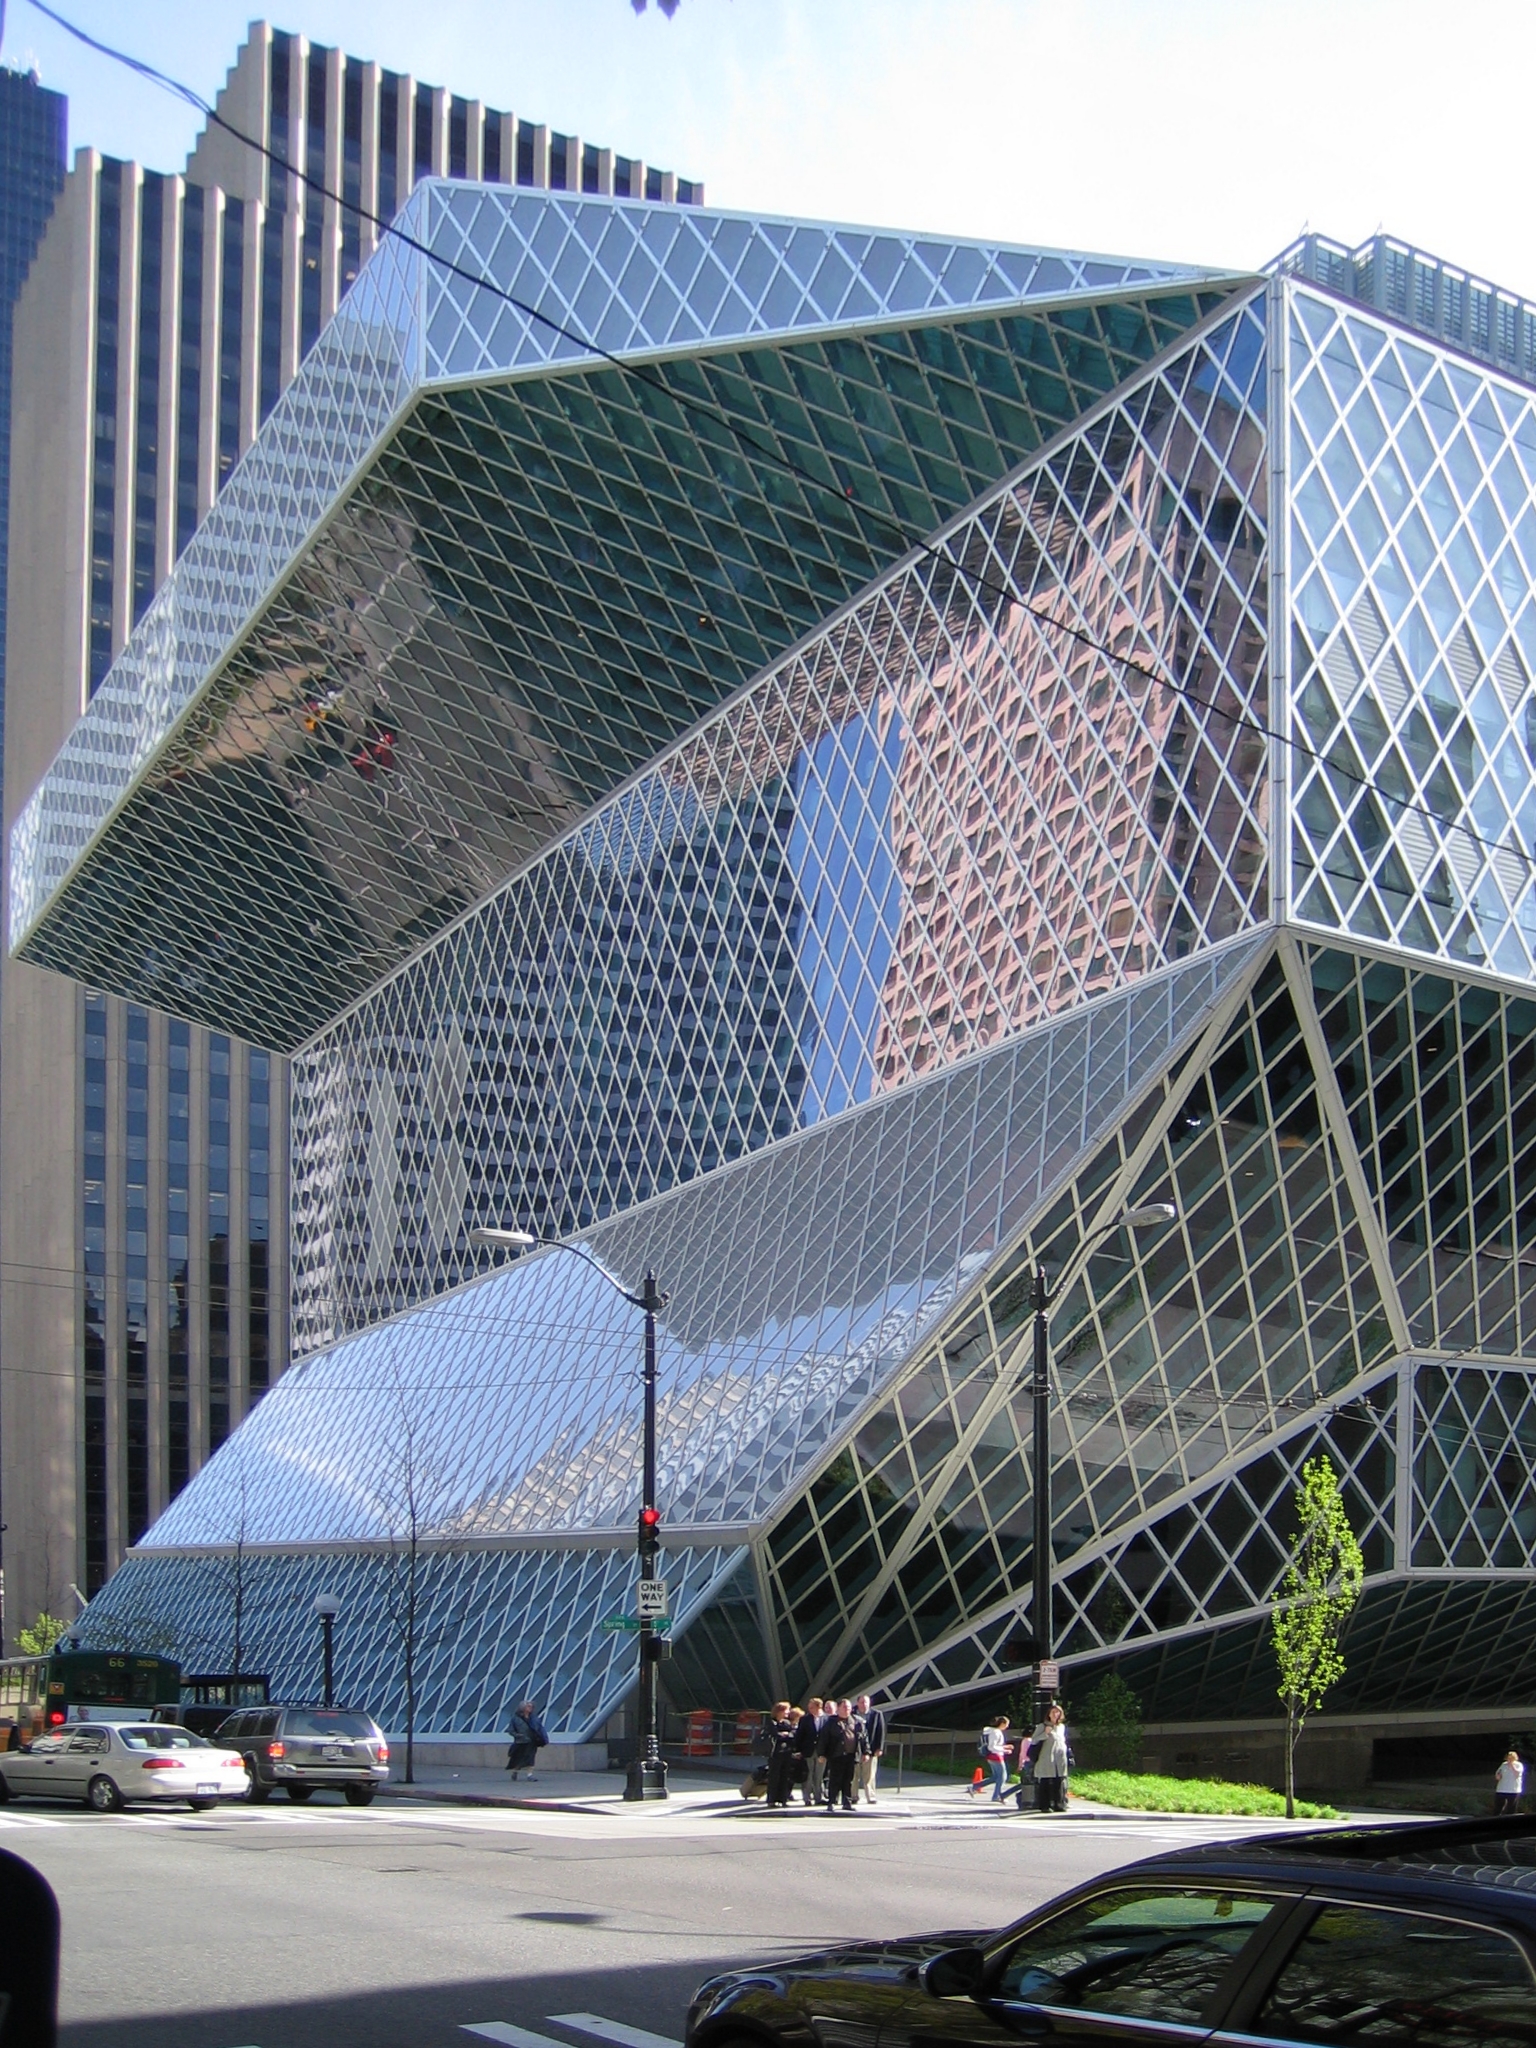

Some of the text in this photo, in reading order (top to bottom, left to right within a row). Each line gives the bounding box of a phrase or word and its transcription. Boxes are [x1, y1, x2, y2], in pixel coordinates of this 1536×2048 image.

[641, 1583, 664, 1592] ONE
[641, 1593, 664, 1601] WAY
[603, 1621, 625, 1630] Spring
[109, 1657, 125, 1668] 66
